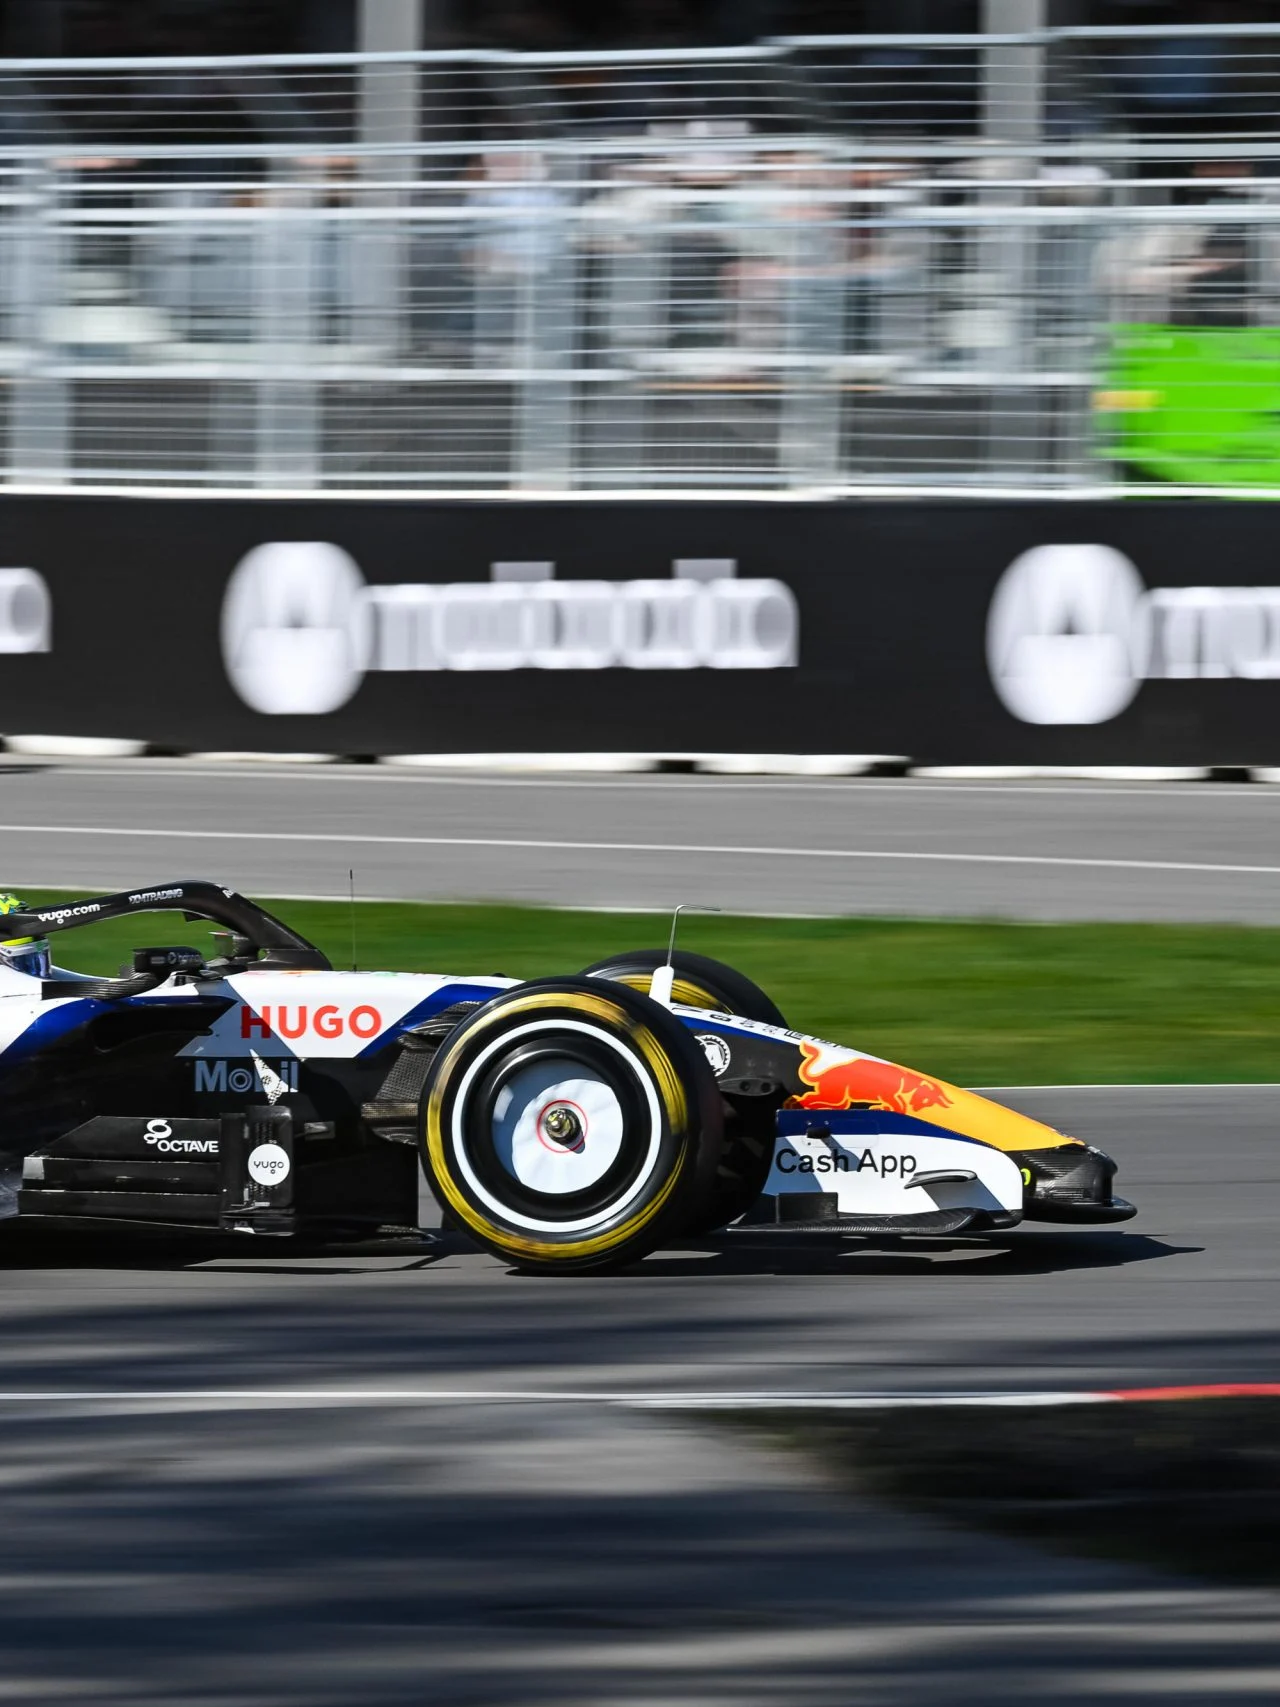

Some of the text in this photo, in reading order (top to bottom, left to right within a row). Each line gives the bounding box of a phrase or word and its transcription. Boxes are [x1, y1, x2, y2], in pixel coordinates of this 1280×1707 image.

[38, 903, 101, 924] yugo.com
[240, 1004, 382, 1039] HUGO
[157, 1140, 220, 1153] OCTAVE
[253, 1161, 284, 1174] yugo
[775, 1148, 917, 1178] Cash App
